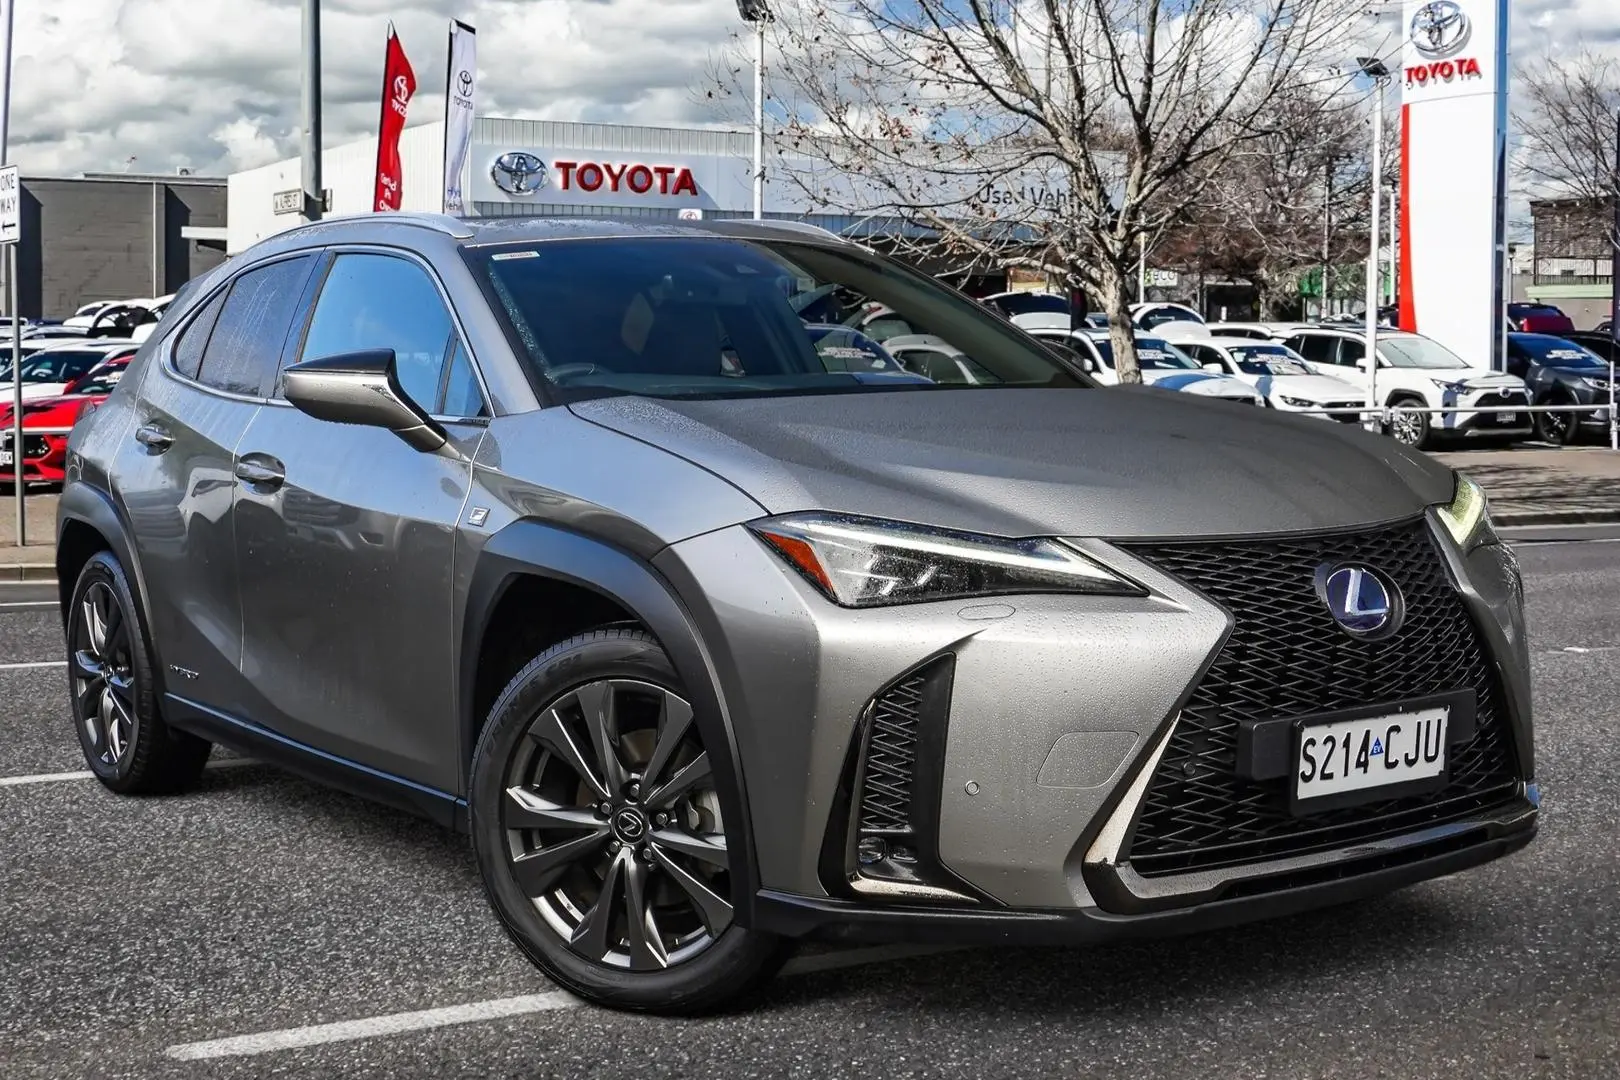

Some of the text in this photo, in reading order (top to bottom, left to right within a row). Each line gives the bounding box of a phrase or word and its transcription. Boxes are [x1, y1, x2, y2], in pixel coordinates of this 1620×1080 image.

[1404, 58, 1481, 83] TOYOTA
[0, 173, 15, 191] ONE
[555, 161, 698, 196] TOYOTA
